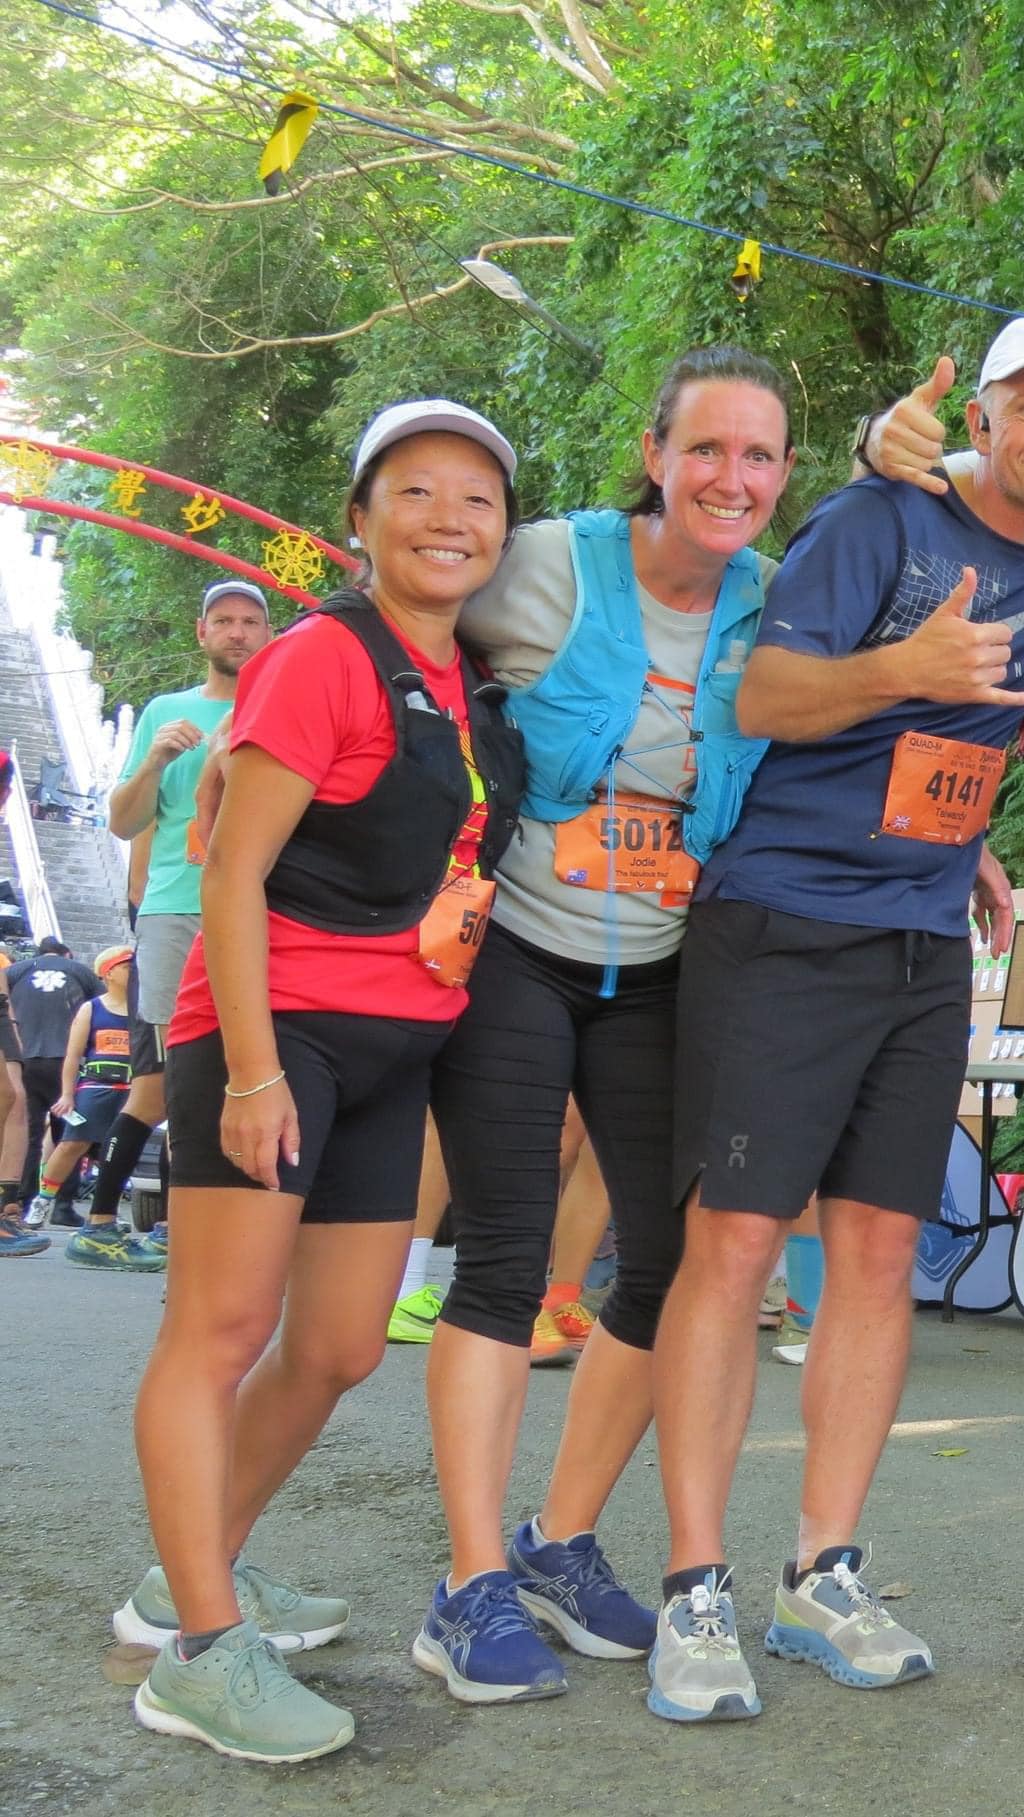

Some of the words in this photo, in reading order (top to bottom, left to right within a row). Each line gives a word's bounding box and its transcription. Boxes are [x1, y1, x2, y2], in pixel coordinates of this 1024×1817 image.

[909, 736, 943, 752] QUAD-M
[925, 769, 985, 807] 4141
[599, 817, 683, 852] 5012
[630, 856, 657, 868] Jodie
